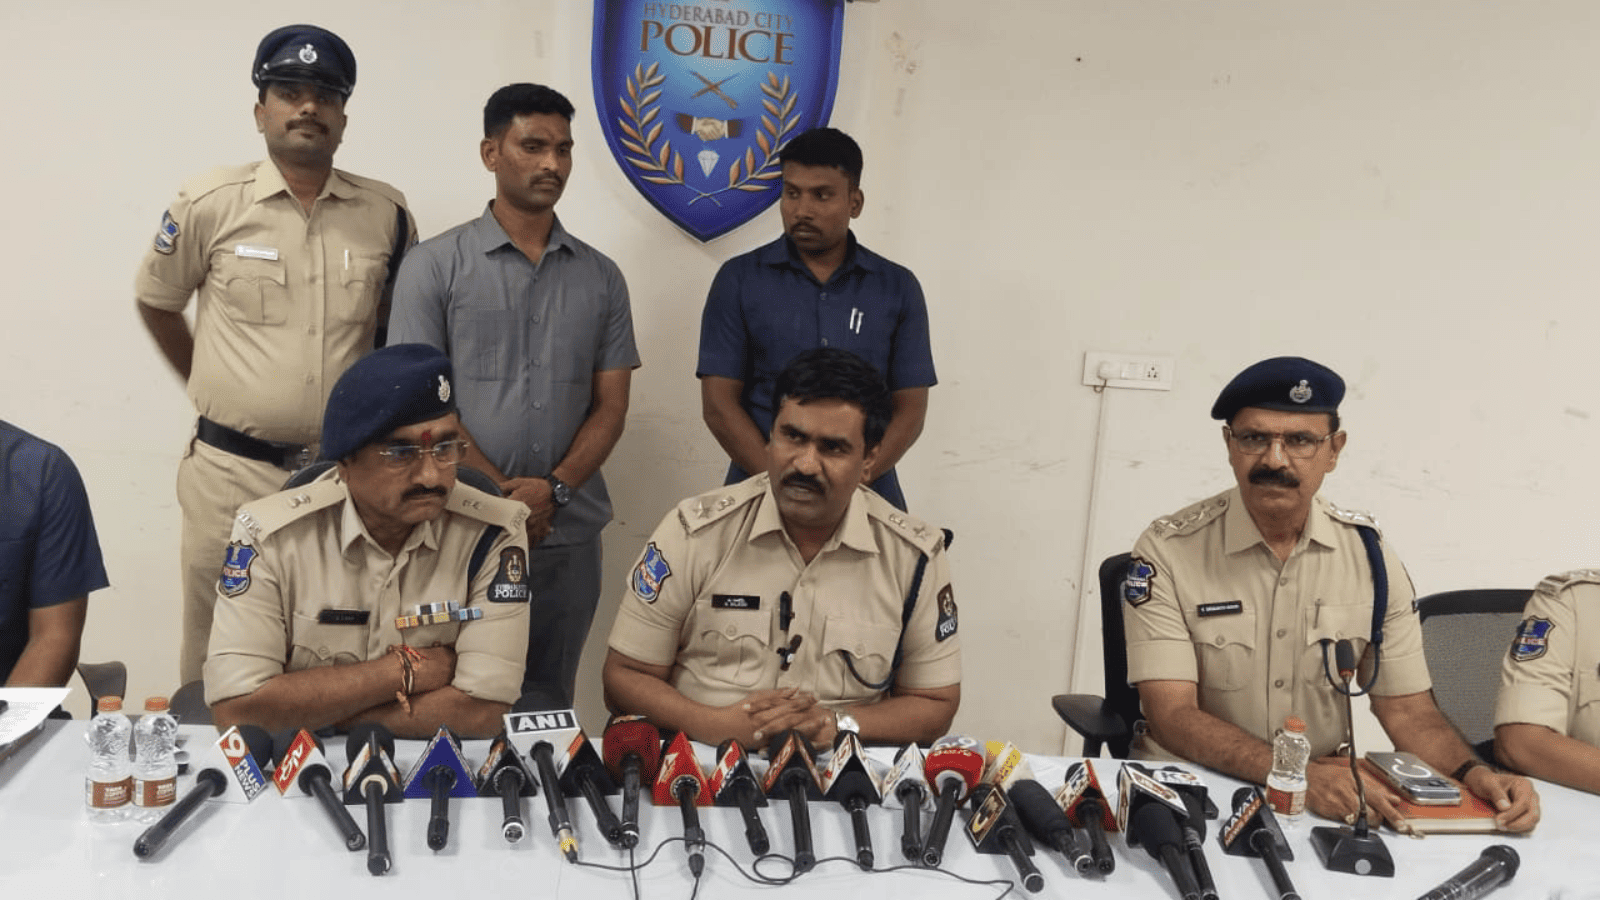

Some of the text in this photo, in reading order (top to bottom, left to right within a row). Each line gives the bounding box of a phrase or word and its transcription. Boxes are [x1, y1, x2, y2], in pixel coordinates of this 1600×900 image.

[644, 1, 794, 29] HYDERABAD CITY
[641, 20, 794, 65] POLICE
[518, 714, 567, 730] ANI
[223, 732, 246, 758] 9
